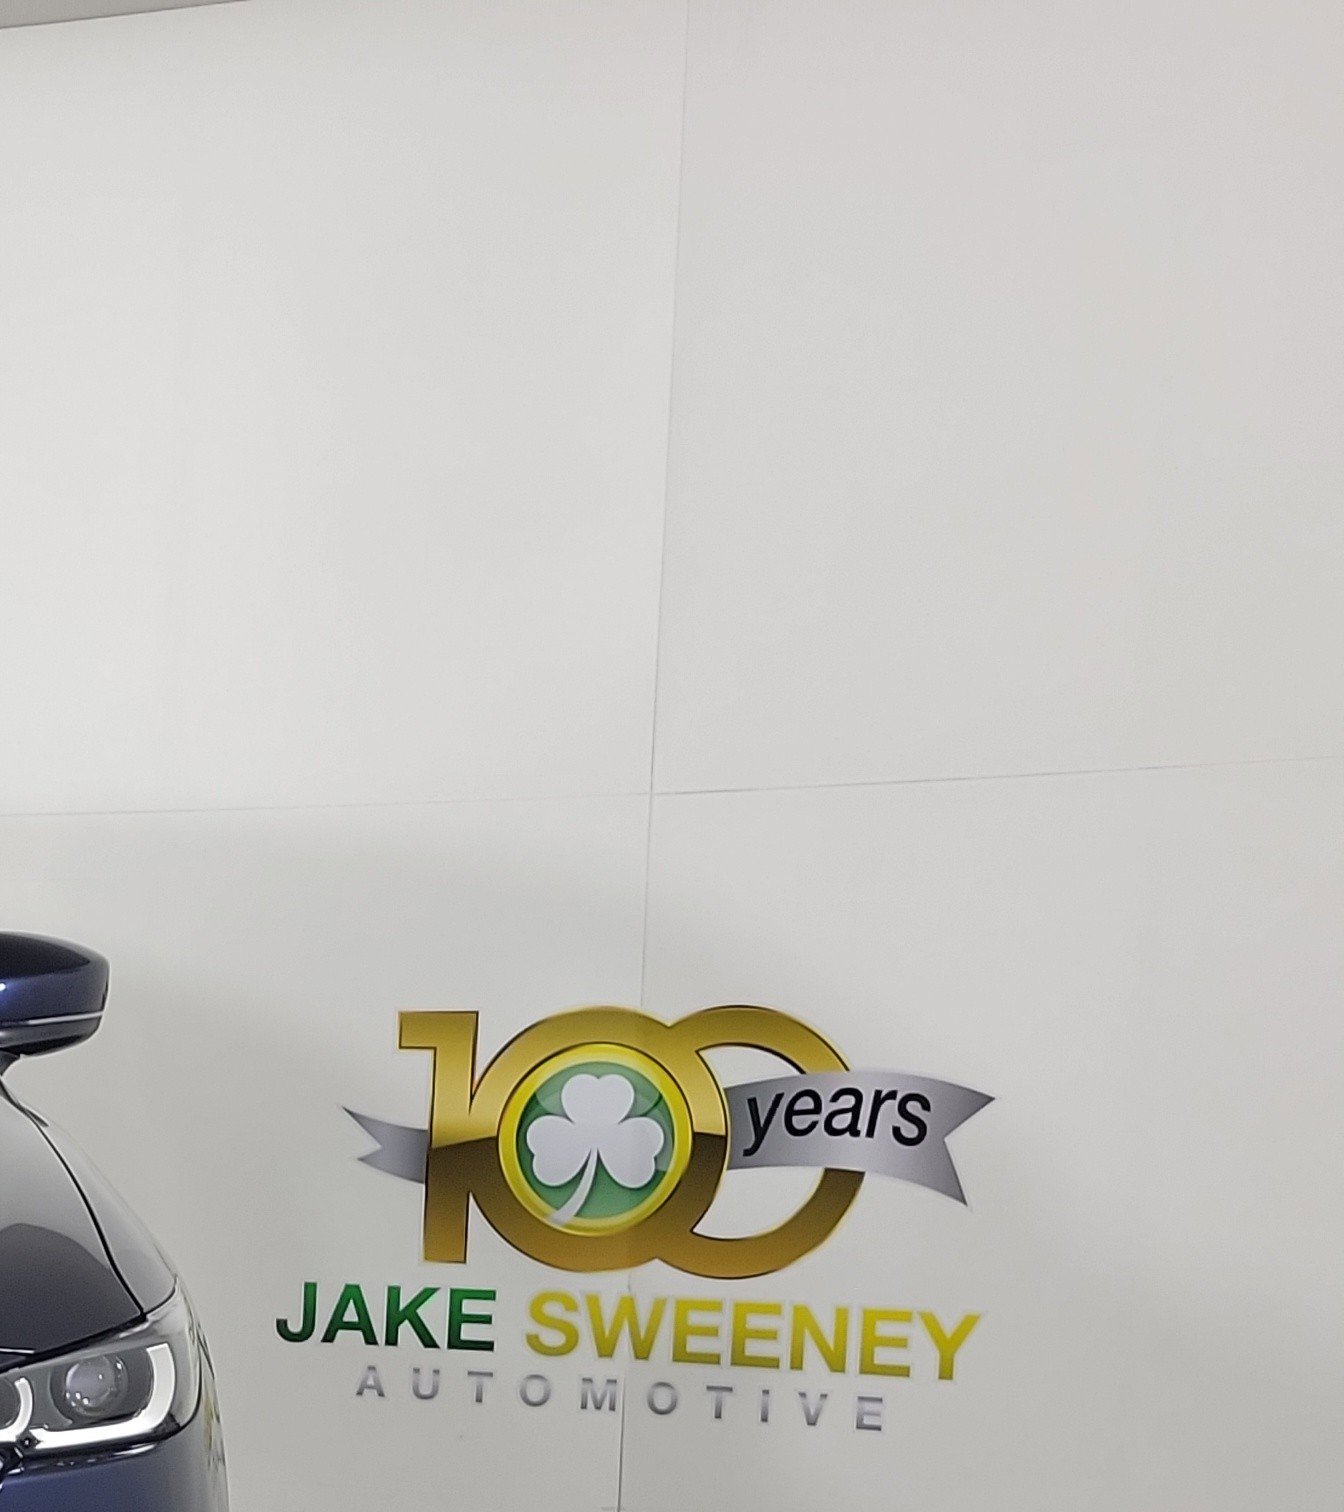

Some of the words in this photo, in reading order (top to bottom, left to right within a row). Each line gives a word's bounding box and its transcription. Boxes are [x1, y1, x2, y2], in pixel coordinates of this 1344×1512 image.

[743, 1086, 933, 1157] years
[275, 1281, 497, 1352] JAKE
[525, 1291, 981, 1381] SWEENEY
[355, 1364, 884, 1432] AUTOMOTIVE
